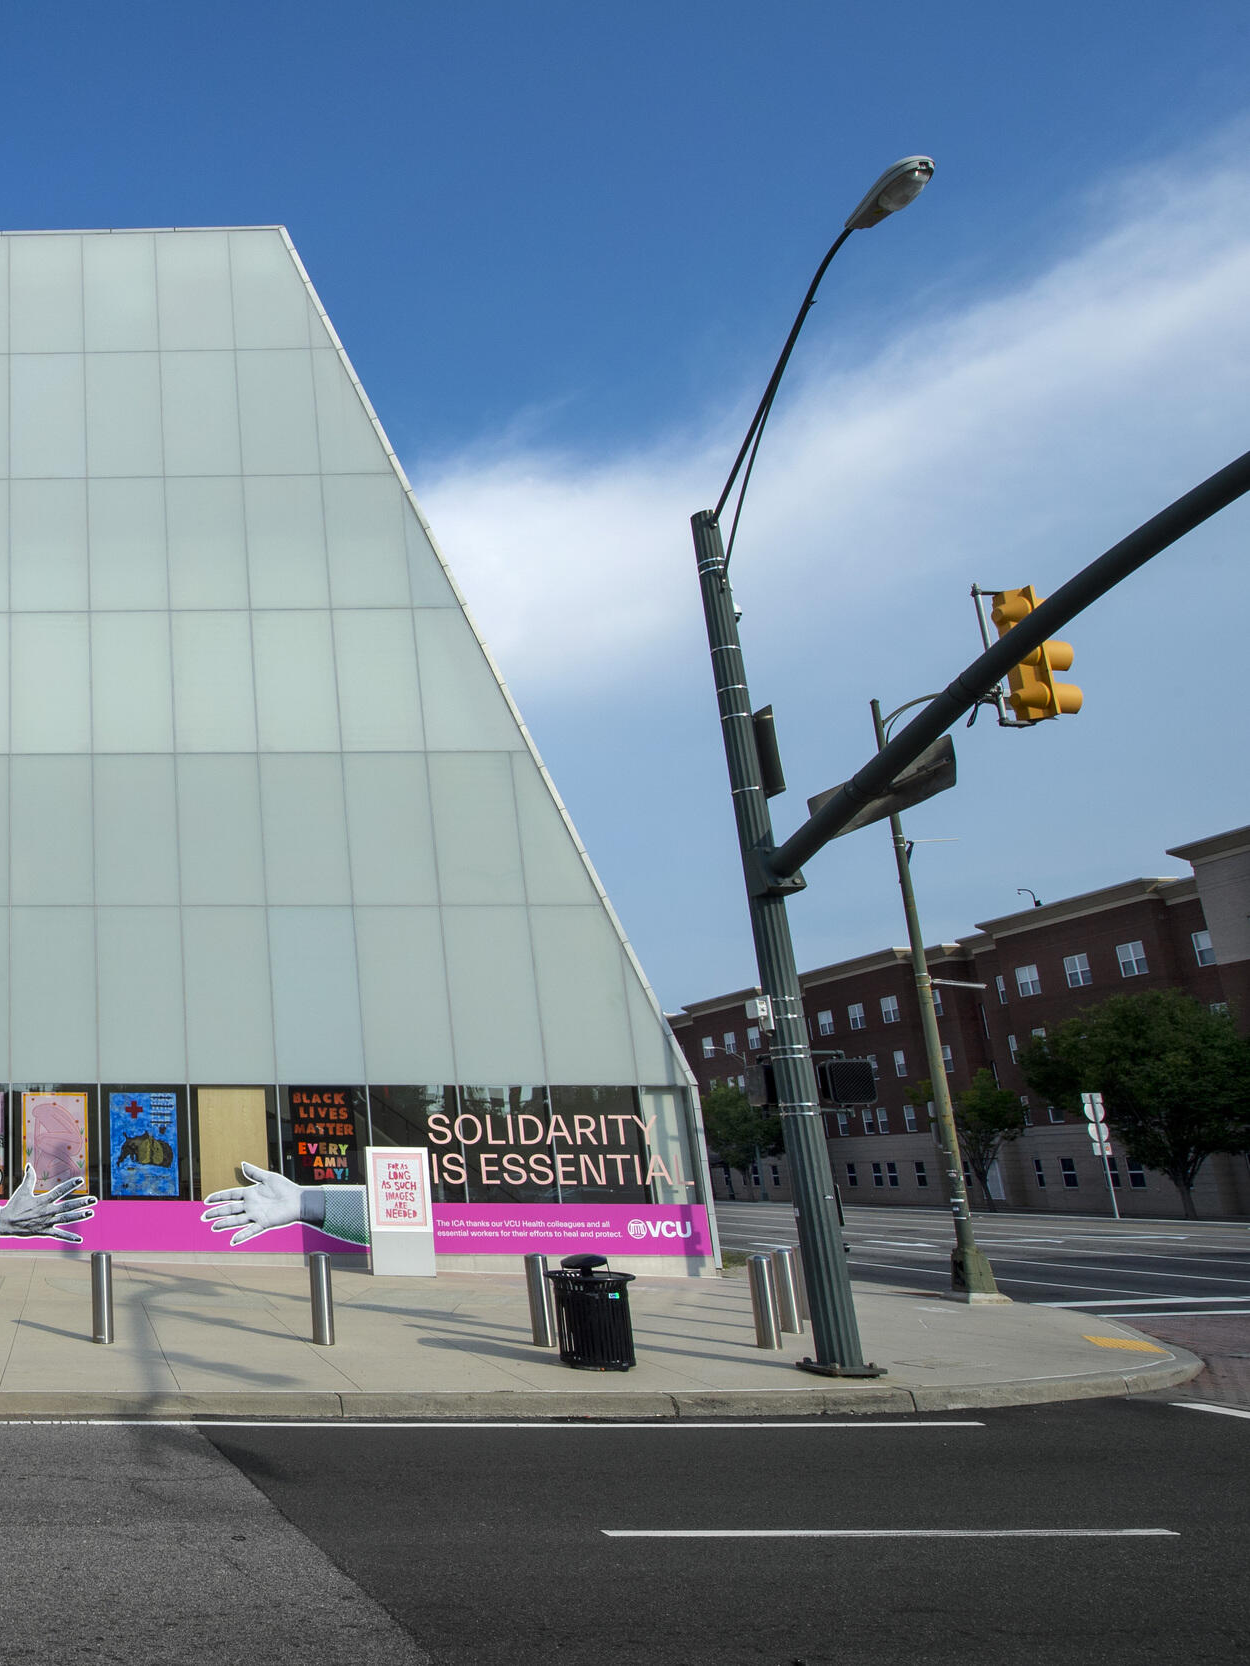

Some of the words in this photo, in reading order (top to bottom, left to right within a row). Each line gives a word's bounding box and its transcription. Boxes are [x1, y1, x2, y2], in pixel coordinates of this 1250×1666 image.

[292, 1092, 345, 1105] BLACK
[298, 1106, 349, 1120] LIVES
[293, 1122, 355, 1136] MATTER
[427, 1113, 659, 1146] SOLIDARITY
[298, 1141, 349, 1155] EVERY
[301, 1156, 348, 1167] DAMN
[313, 1167, 350, 1181] DAY!
[388, 1171, 411, 1180] LONG
[431, 1152, 468, 1185] IS
[479, 1152, 696, 1186] ESSENTIAL
[381, 1181, 392, 1190] AS
[394, 1181, 417, 1191] SUCH
[385, 1191, 415, 1202] IMAGES
[385, 1209, 417, 1219] NEEDED
[522, 1220, 545, 1228] Health
[546, 1220, 585, 1229] colleagues
[646, 1220, 692, 1239] VCU
[595, 1231, 623, 1239] protect.
